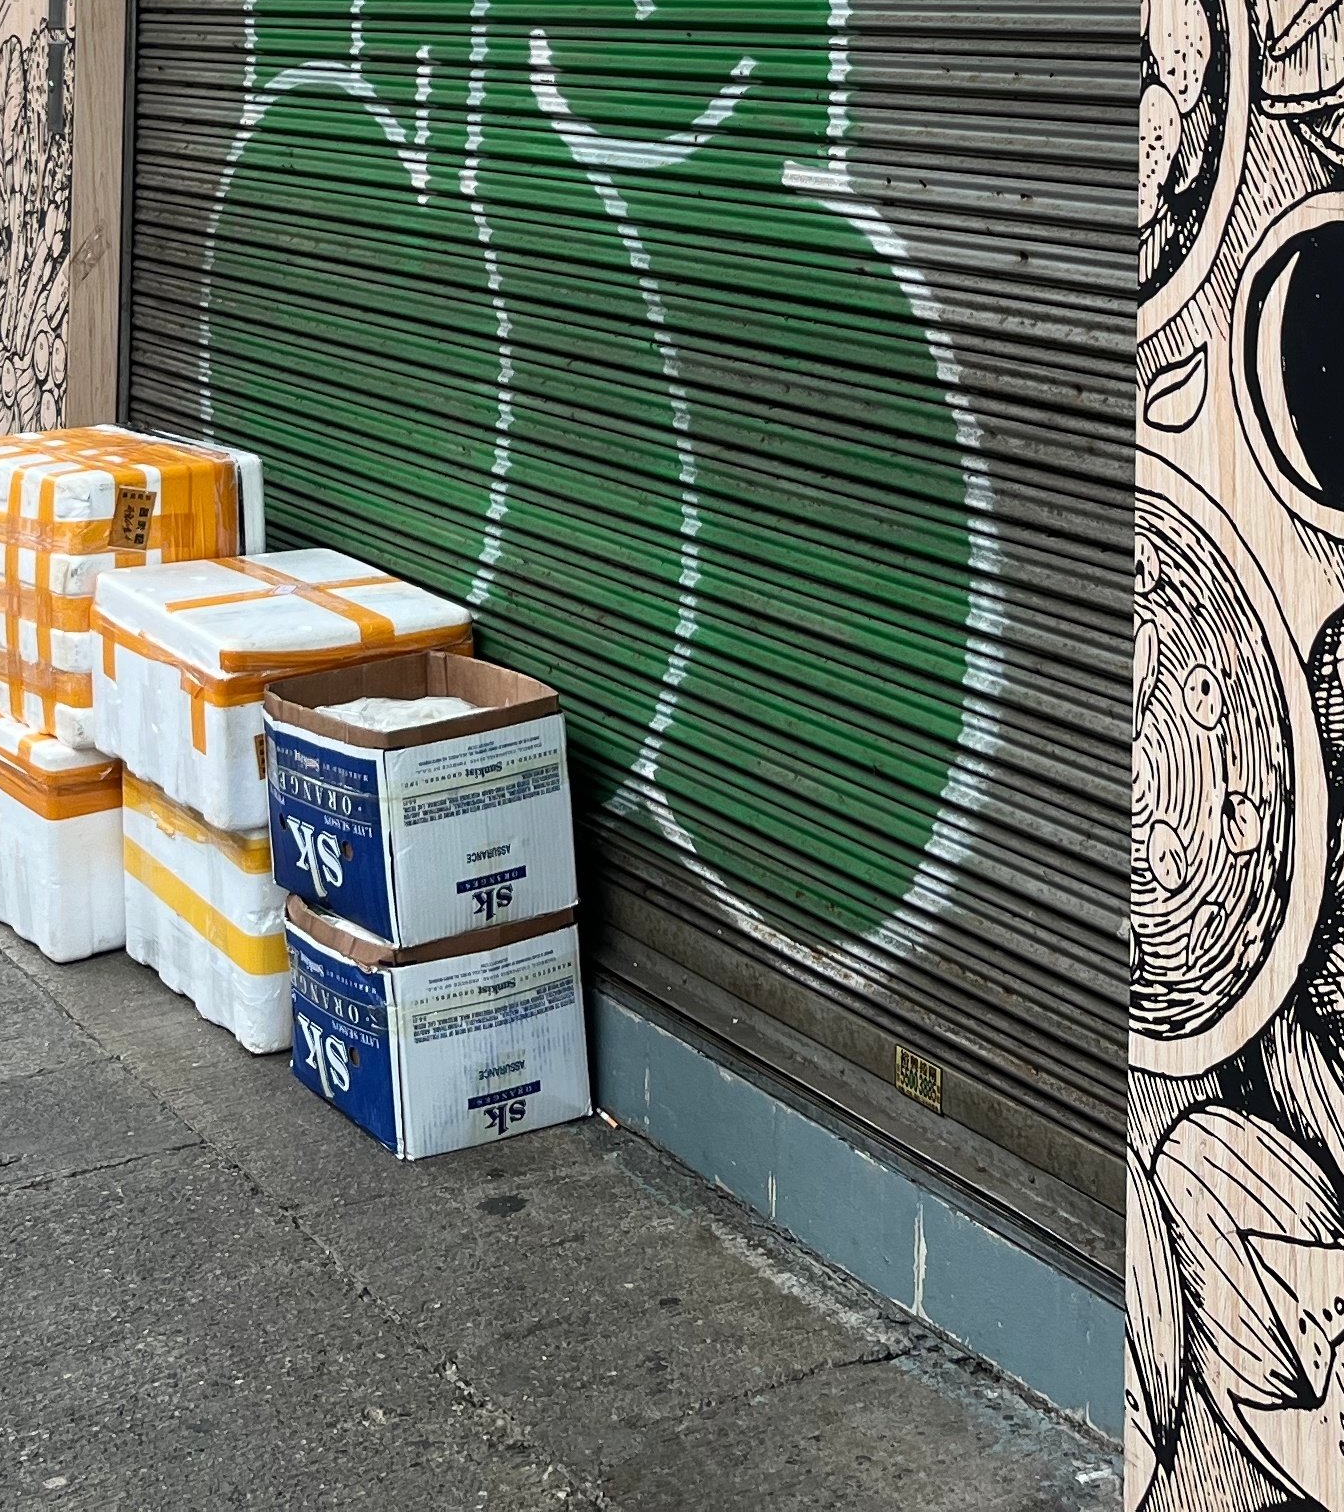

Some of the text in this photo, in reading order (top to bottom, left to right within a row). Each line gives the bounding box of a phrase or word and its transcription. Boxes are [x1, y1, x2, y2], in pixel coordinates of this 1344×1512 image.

[465, 761, 503, 779] Sunkist
[466, 843, 511, 864] ASSURANCE
[477, 976, 517, 996] Sunkist
[479, 1059, 526, 1081] ASSURANCE
